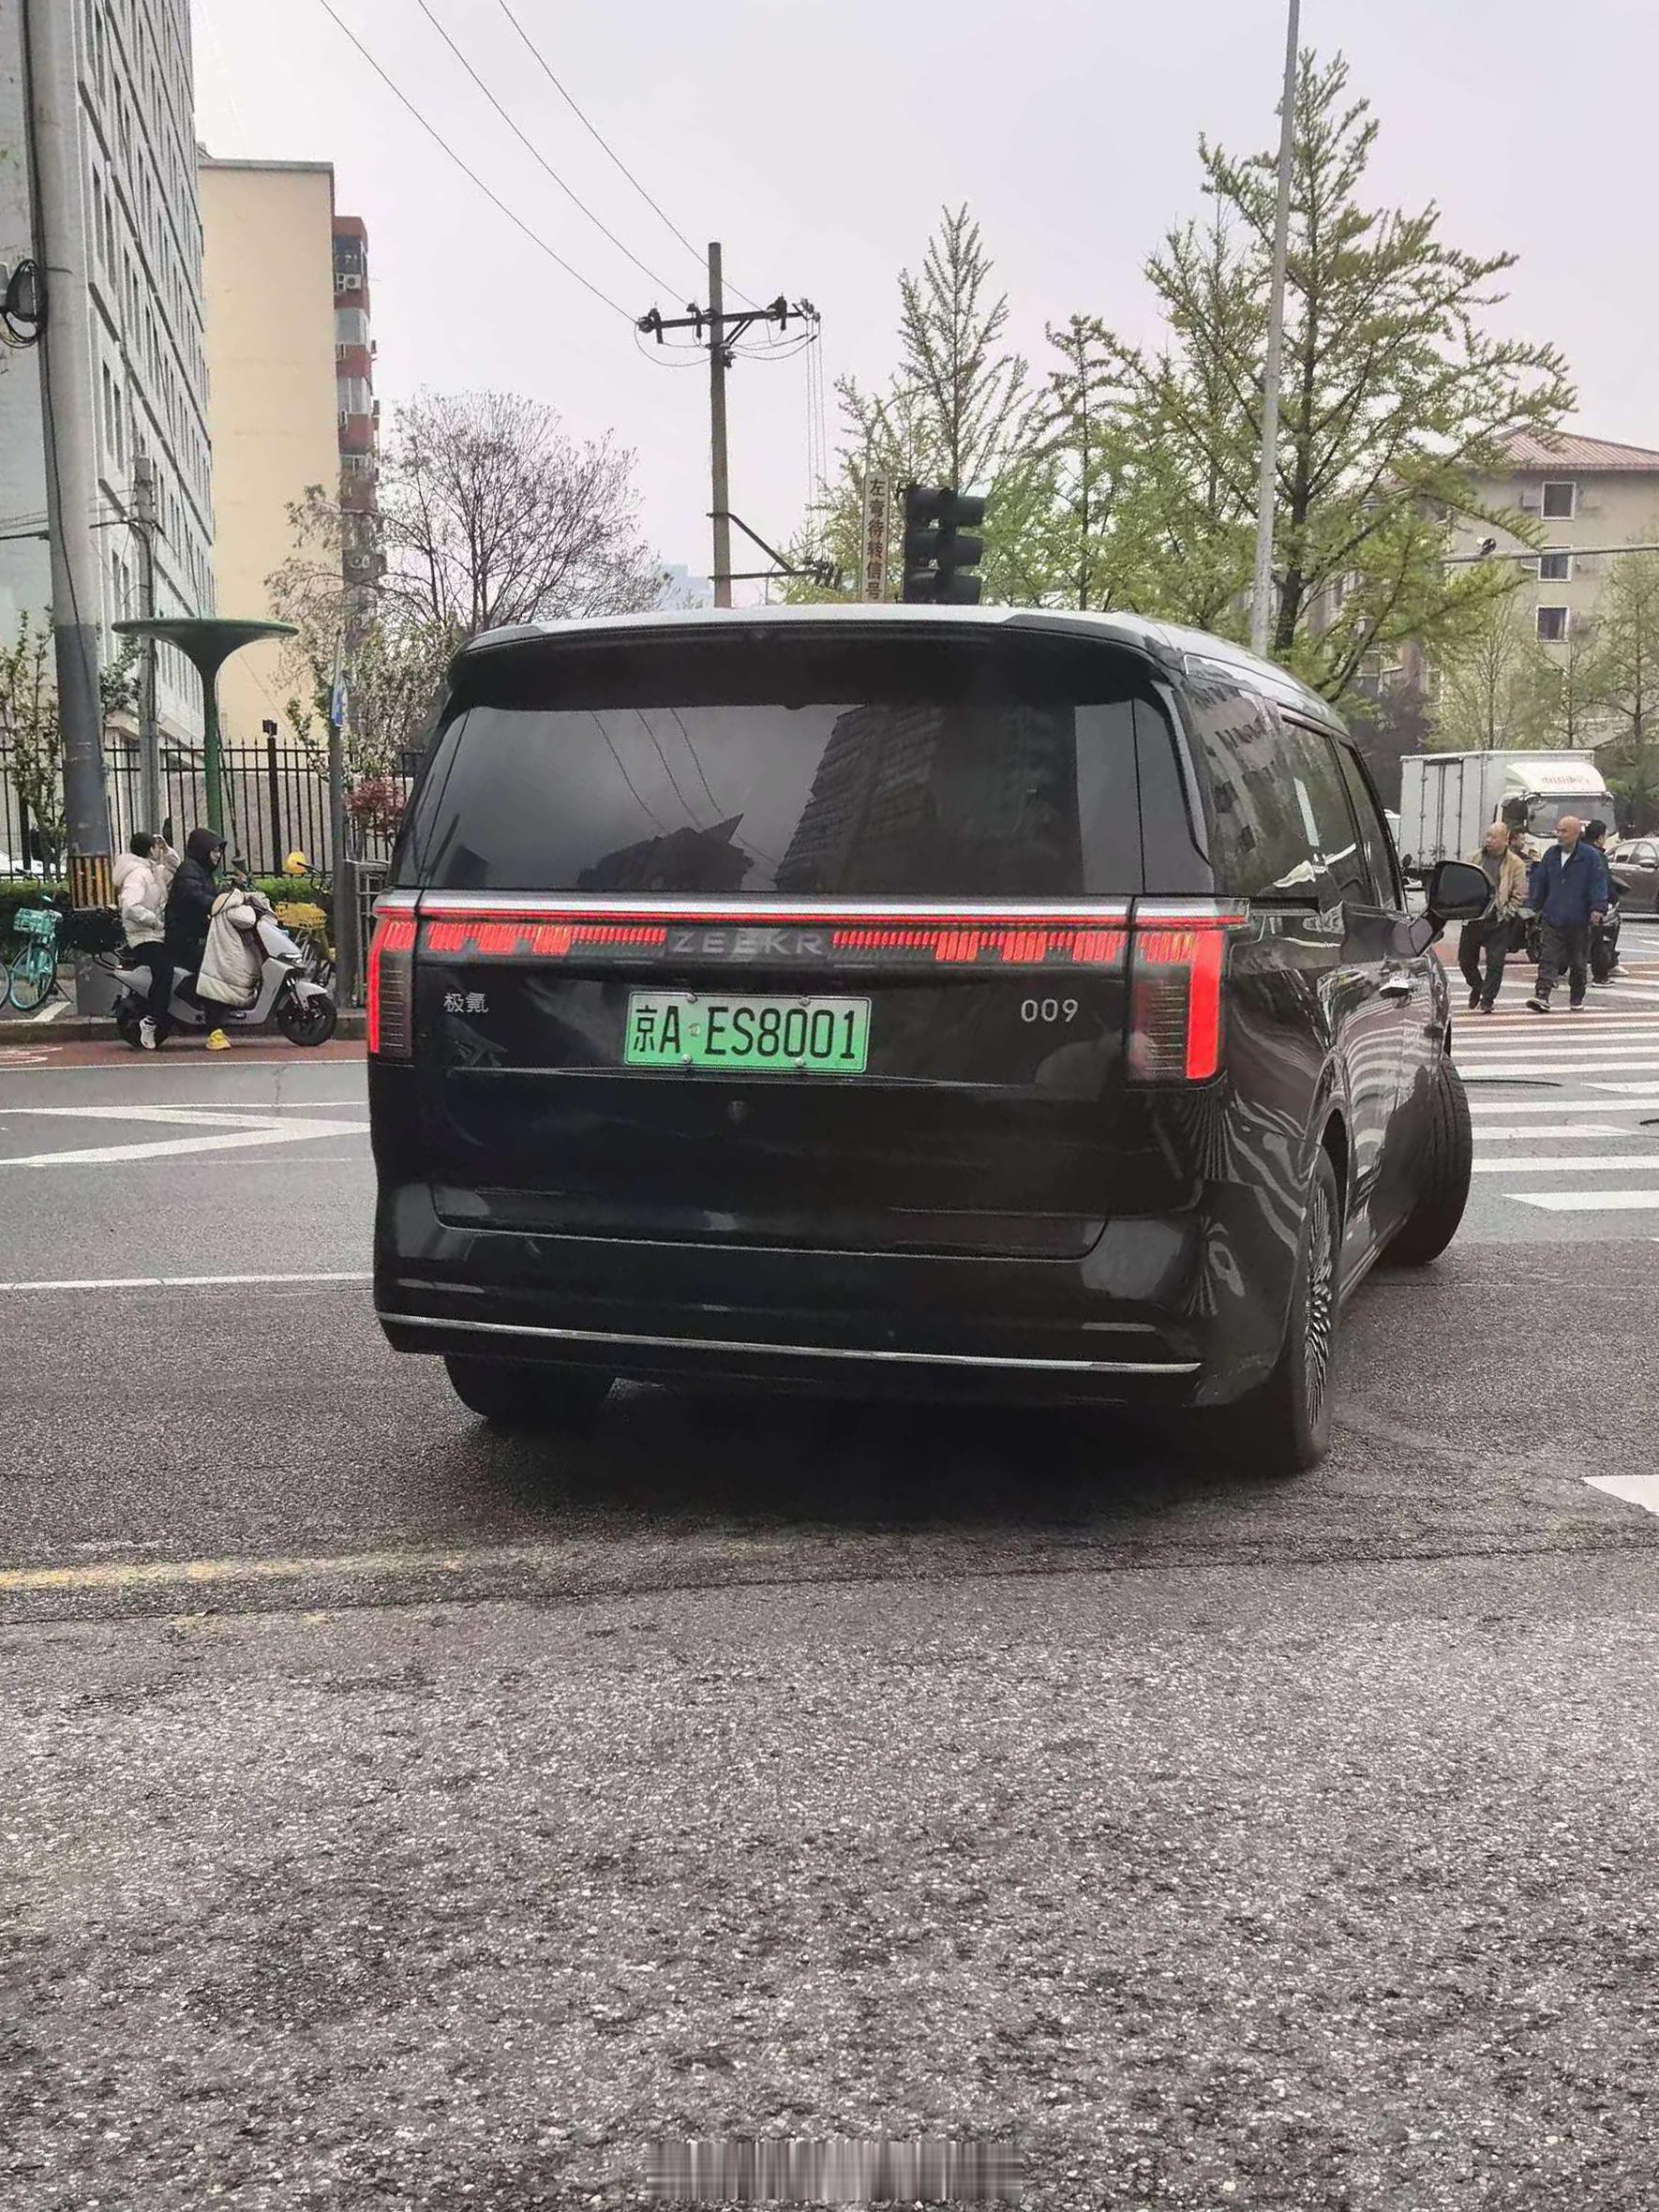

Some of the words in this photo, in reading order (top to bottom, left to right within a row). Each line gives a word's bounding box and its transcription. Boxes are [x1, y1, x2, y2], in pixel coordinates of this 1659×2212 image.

[671, 931, 823, 955] ZEEKR
[442, 992, 489, 1013] 极氪
[1021, 999, 1079, 1023] 009
